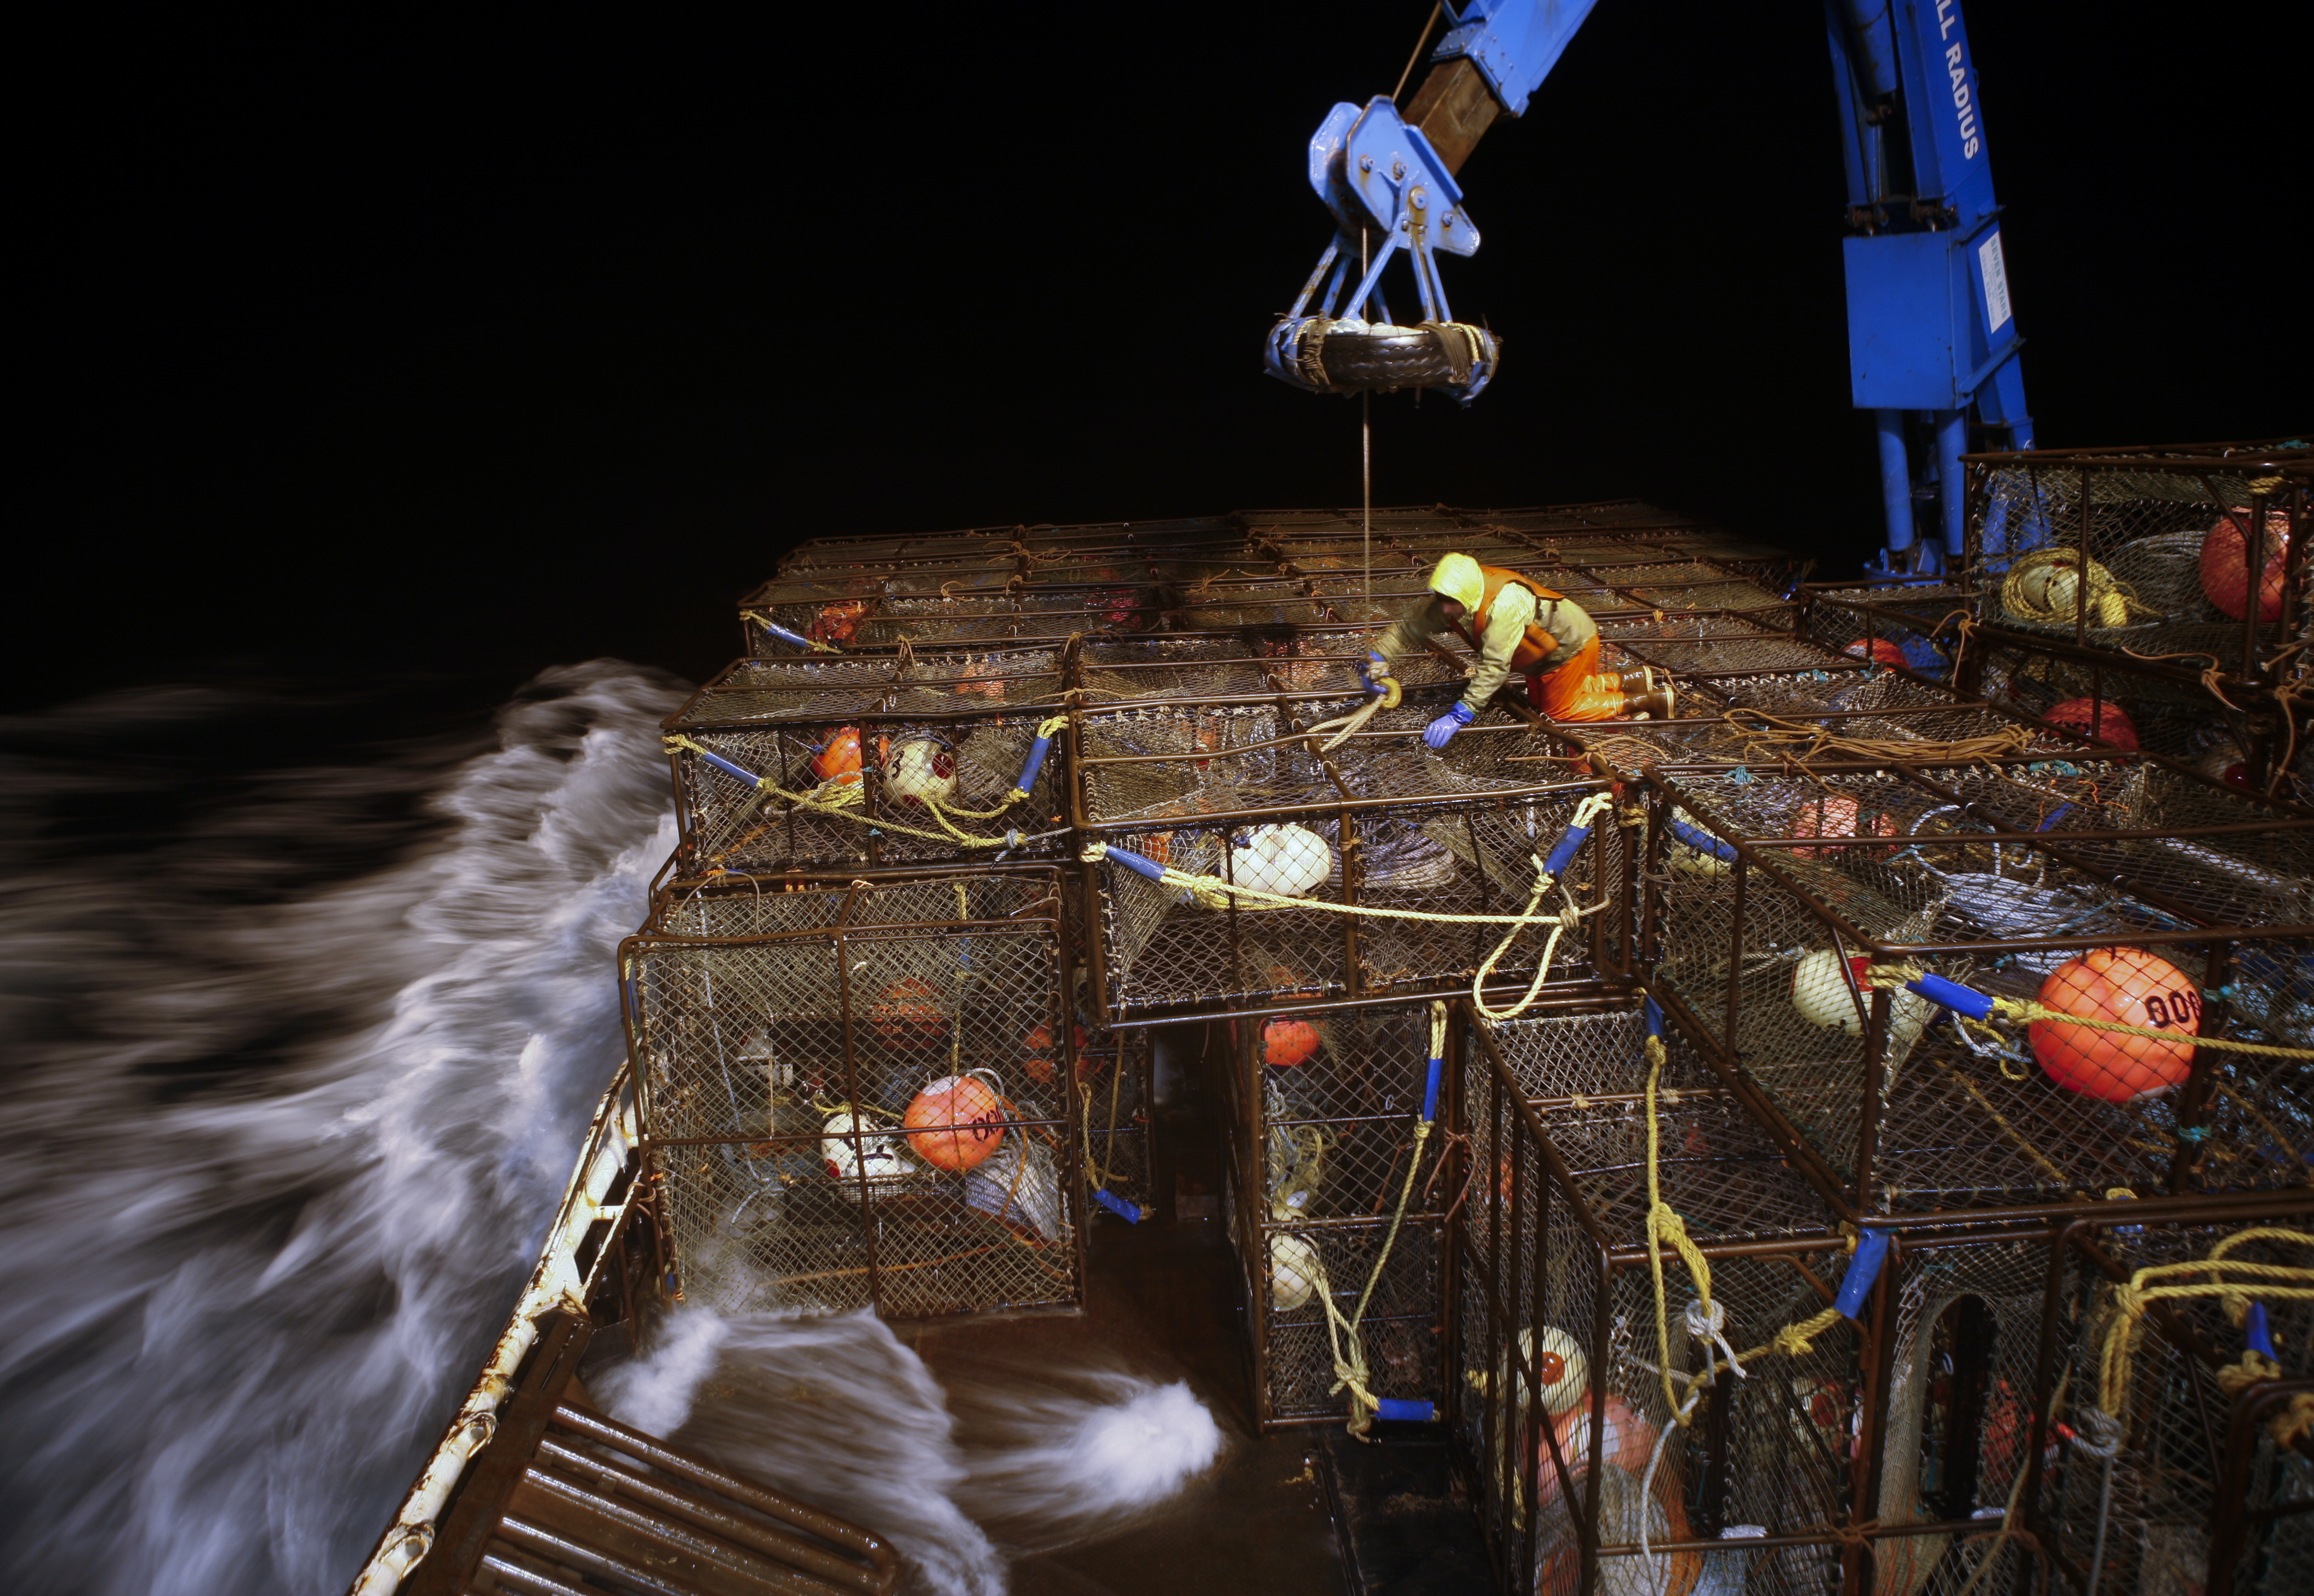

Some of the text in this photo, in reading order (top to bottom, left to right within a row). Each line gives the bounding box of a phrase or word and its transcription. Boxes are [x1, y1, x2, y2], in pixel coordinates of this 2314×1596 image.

[1935, 0, 1979, 160] LL RADIUS
[1990, 238, 2001, 278] SEVEN
[1997, 281, 2008, 319] STARS
